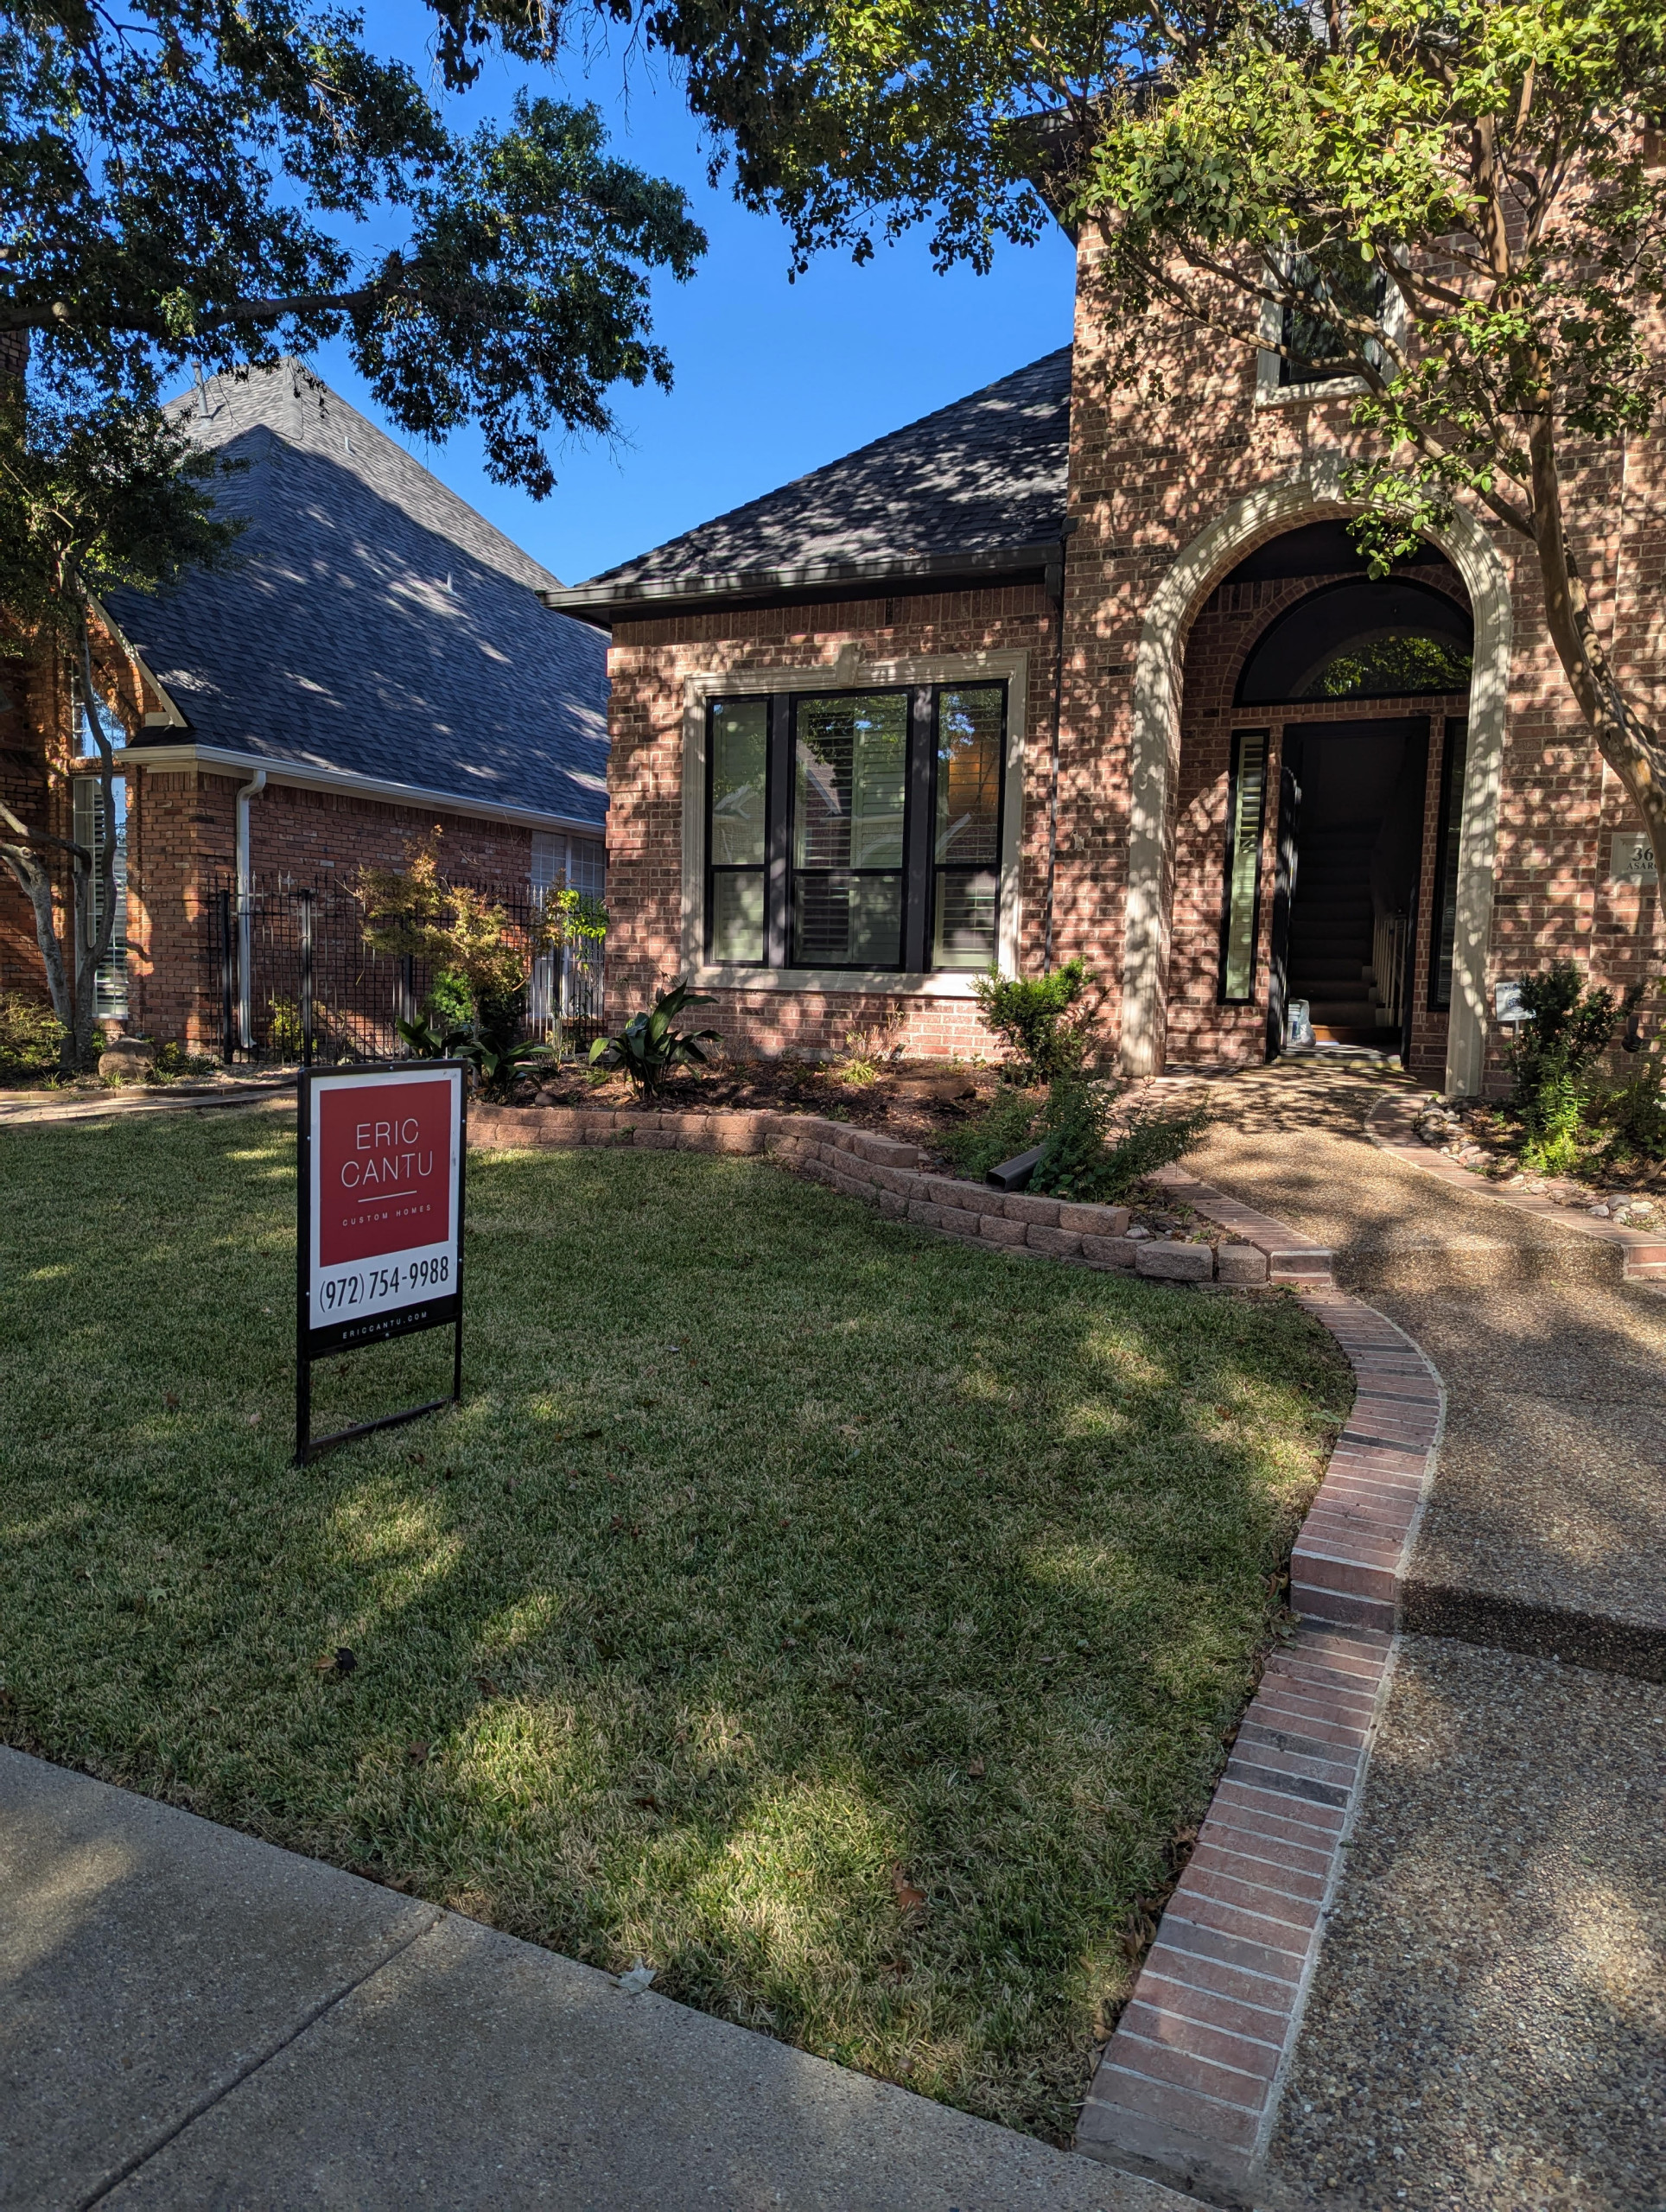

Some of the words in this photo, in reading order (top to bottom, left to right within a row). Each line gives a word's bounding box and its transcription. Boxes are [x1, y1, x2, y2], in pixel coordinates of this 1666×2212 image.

[356, 1118, 420, 1150] ERIC
[340, 1150, 434, 1188] CANTU
[342, 1212, 389, 1227] CUSTOM
[396, 1204, 432, 1217] HOMES
[319, 1272, 365, 1313] (972)
[369, 1255, 449, 1300] 754-9988
[342, 1311, 428, 1339] ERICCANTU.COM
